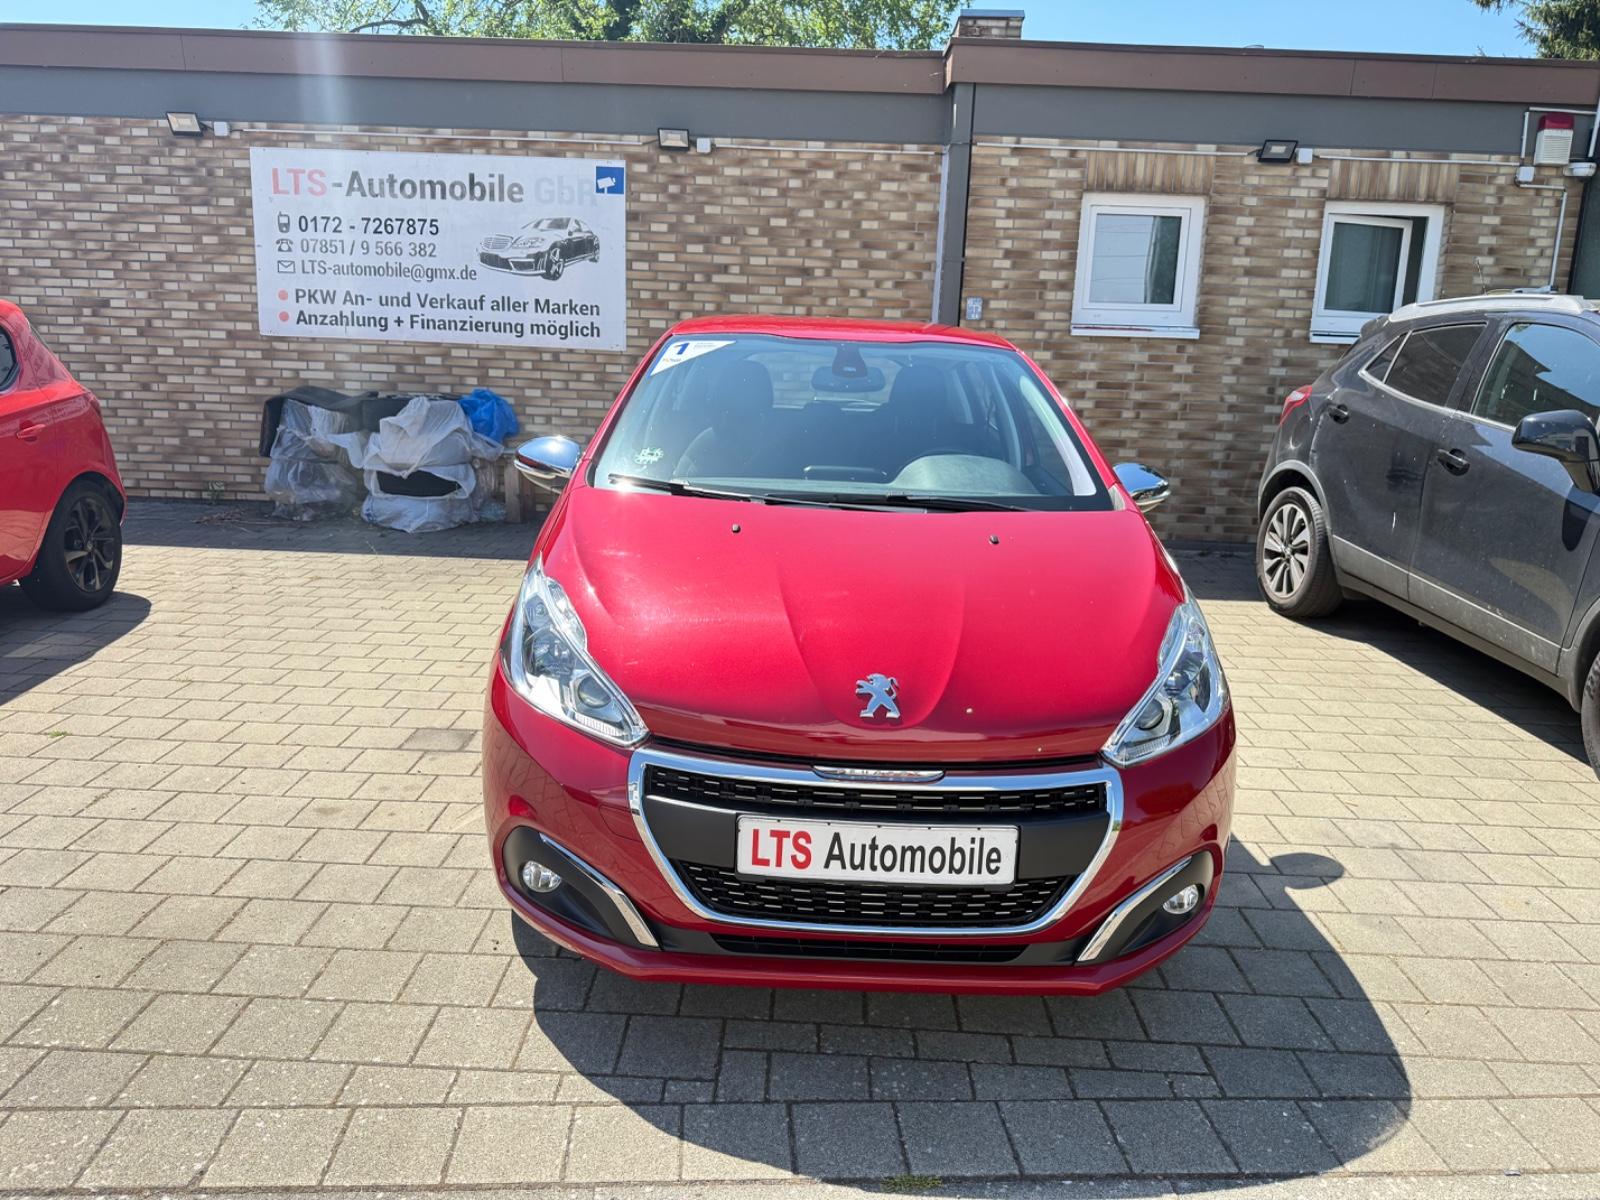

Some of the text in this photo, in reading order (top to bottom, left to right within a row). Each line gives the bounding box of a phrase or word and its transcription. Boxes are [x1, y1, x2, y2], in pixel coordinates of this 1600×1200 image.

[298, 215, 342, 233] 0172
[361, 217, 439, 235] 7267875
[300, 238, 437, 258] 07851 / 9 566 382
[301, 259, 477, 283] LTS-automobile@gmx.de
[295, 288, 600, 316] PKW An- und Verkauf aller Marken
[296, 310, 600, 340] Anzahlung + Finanzierung möglich
[751, 828, 1001, 875] LTS Automobile
